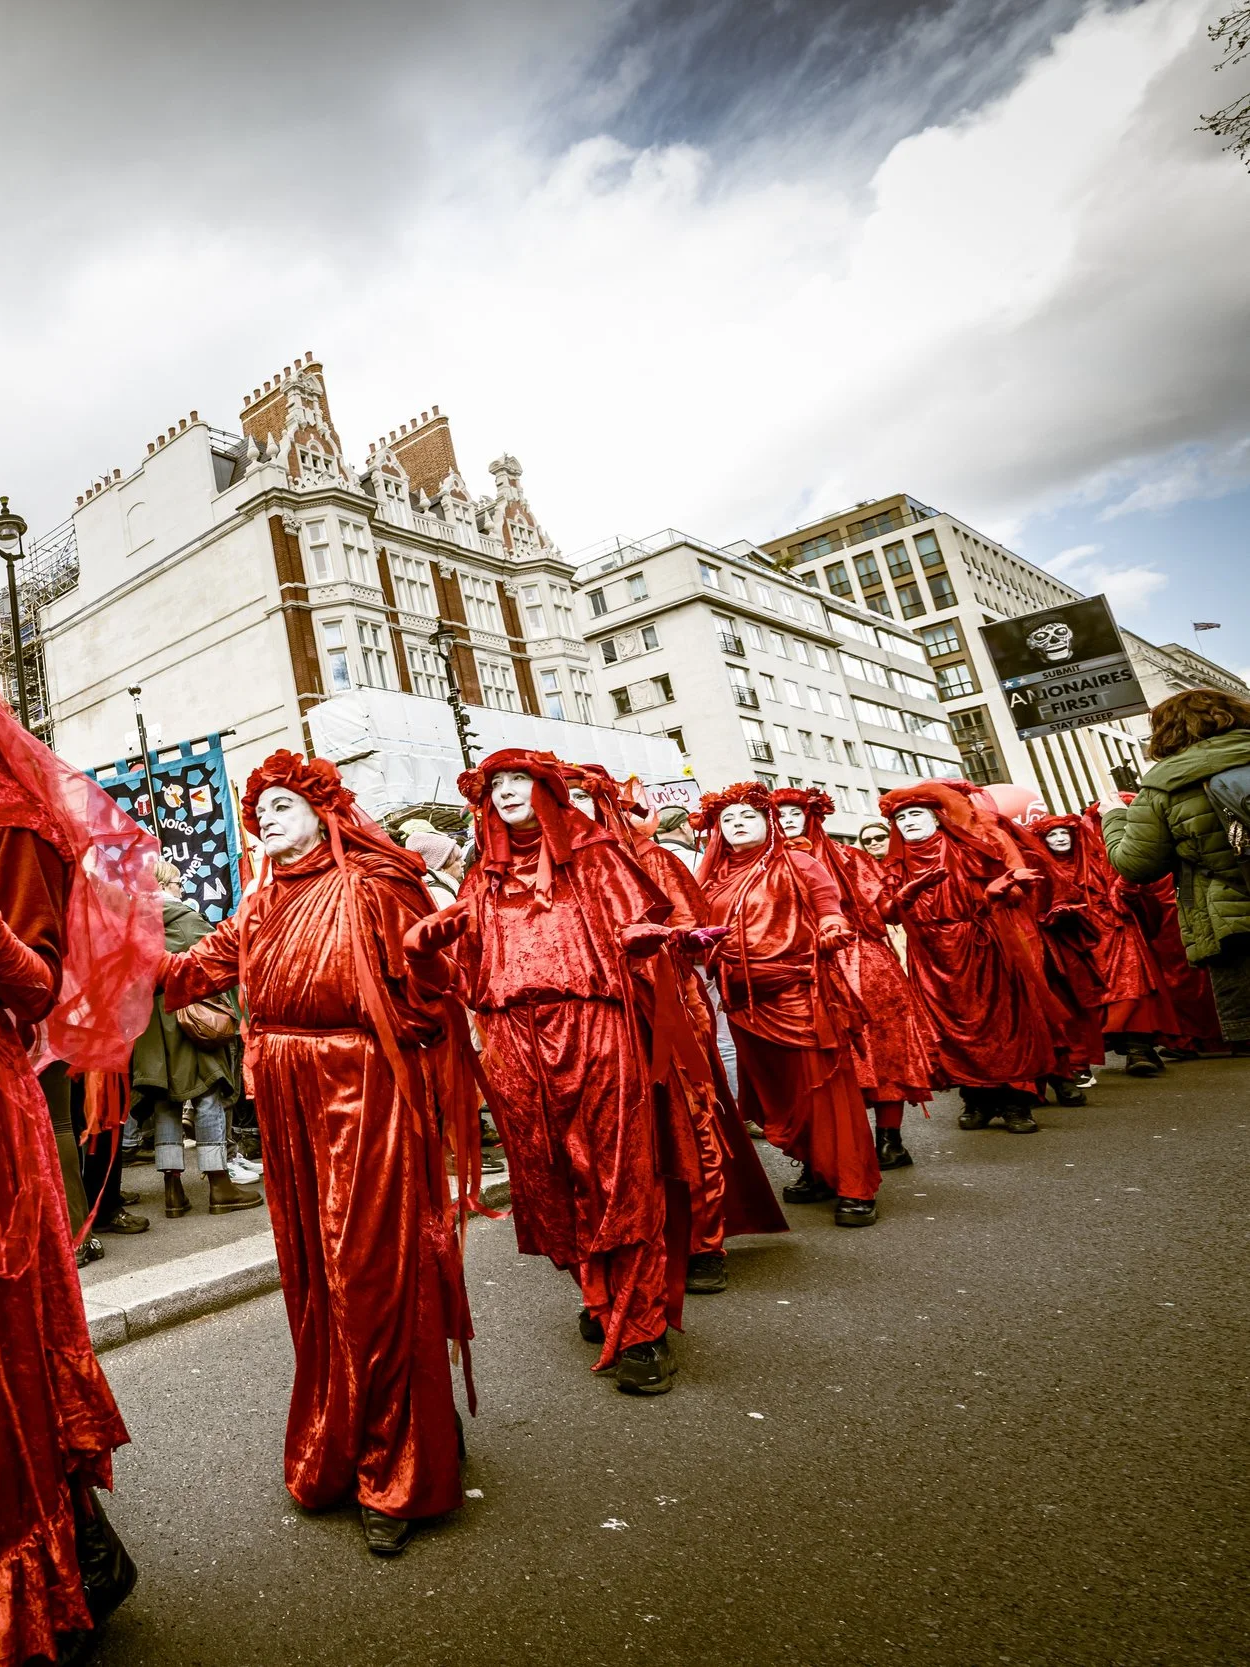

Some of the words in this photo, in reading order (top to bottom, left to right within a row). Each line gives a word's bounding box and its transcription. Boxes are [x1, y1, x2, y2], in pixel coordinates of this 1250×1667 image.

[1042, 664, 1081, 679] SUBMIT
[1050, 693, 1099, 715] FIRST
[1049, 719, 1075, 732] STAY
[1077, 711, 1114, 726] ASLEEP
[652, 787, 690, 803] unity
[159, 818, 194, 836] voice
[179, 853, 204, 885] ower
